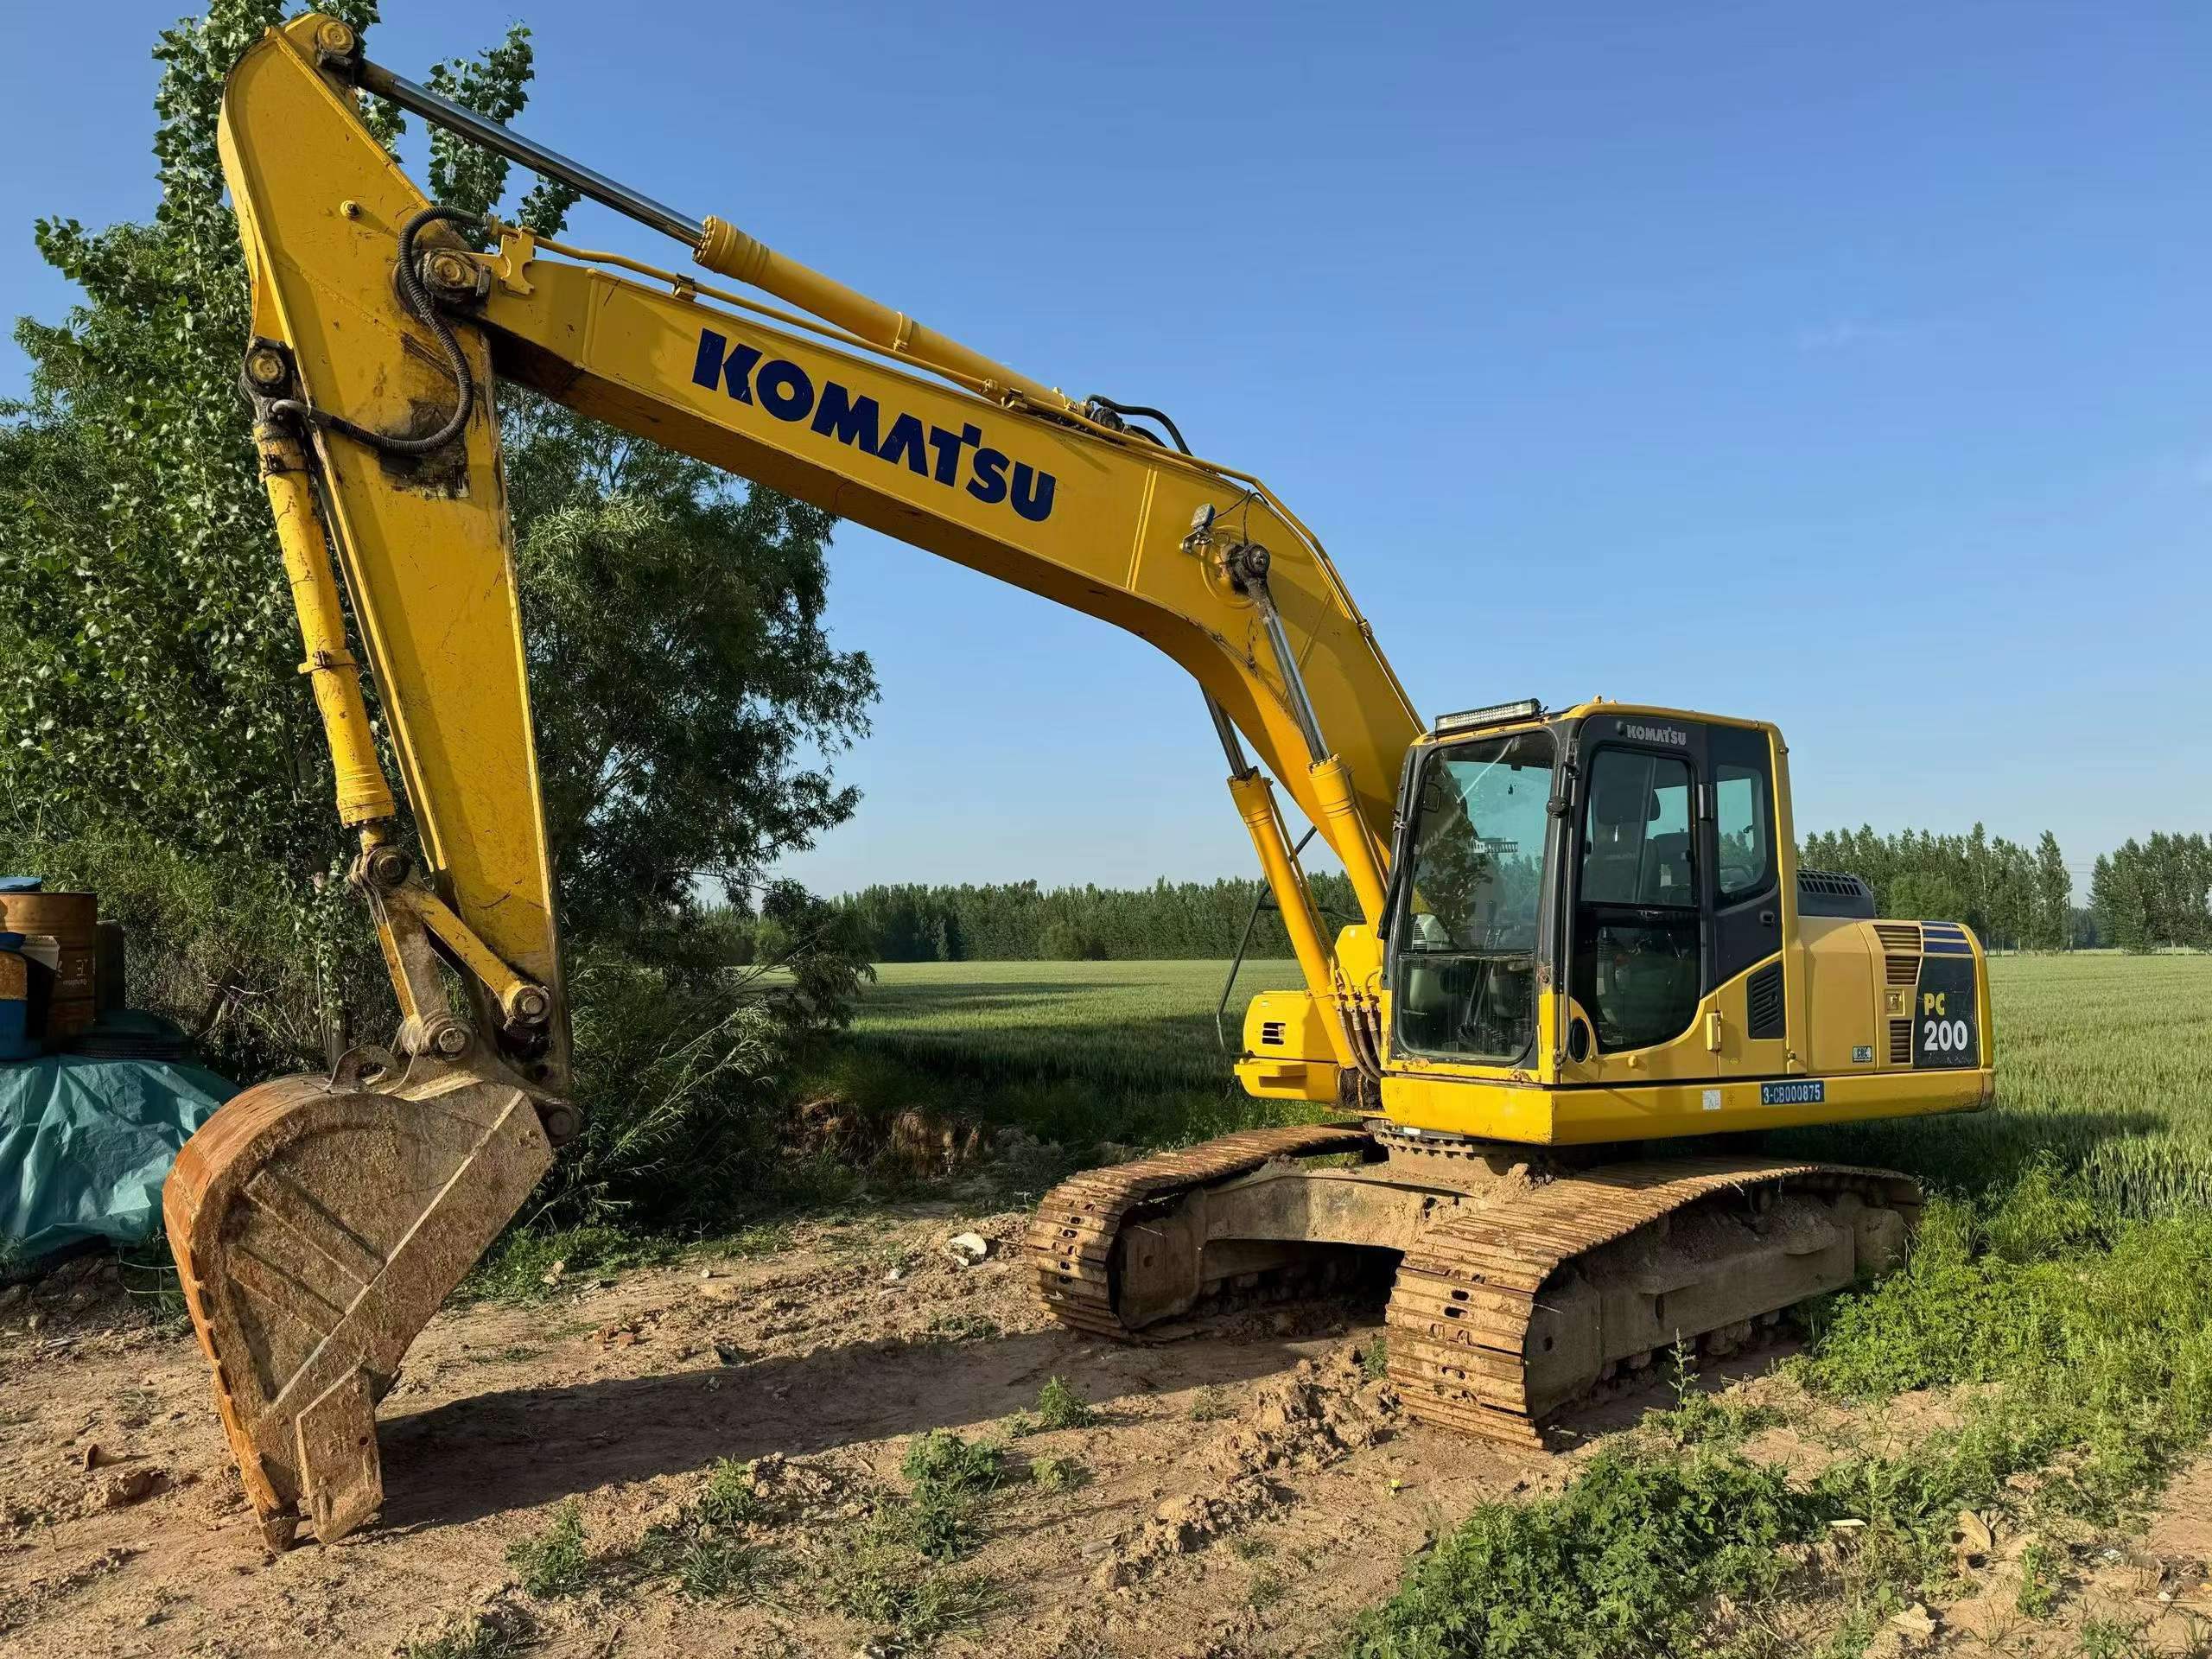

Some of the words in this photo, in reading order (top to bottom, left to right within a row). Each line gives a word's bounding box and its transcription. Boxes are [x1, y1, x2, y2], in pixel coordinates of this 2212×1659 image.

[692, 327, 1056, 522] KOMATSU
[1626, 724, 1687, 746] KOMATSU
[1923, 993, 1945, 1016] PC
[1923, 1020, 1968, 1051] 200
